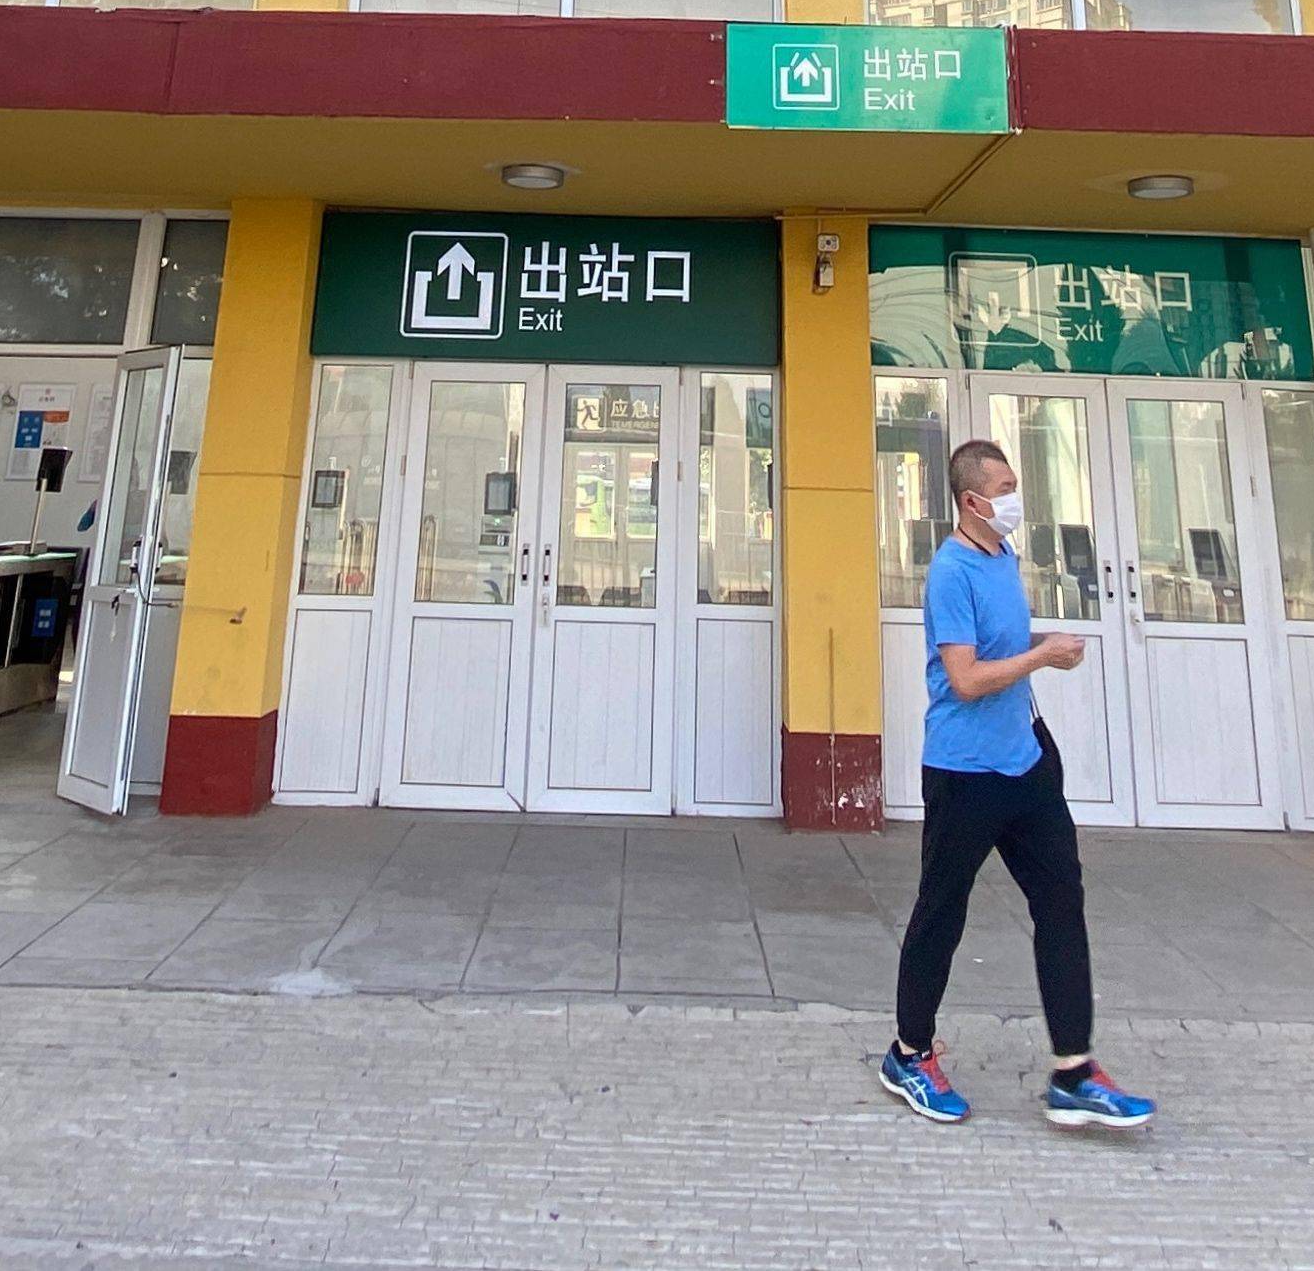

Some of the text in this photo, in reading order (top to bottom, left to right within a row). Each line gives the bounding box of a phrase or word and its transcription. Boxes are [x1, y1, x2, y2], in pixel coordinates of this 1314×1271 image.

[862, 46, 962, 81] 出站口
[863, 87, 916, 111] Exit
[519, 241, 691, 303] 出站口
[1053, 263, 1193, 312] 出站口
[518, 307, 564, 332] Exit
[1055, 317, 1104, 342] Exit
